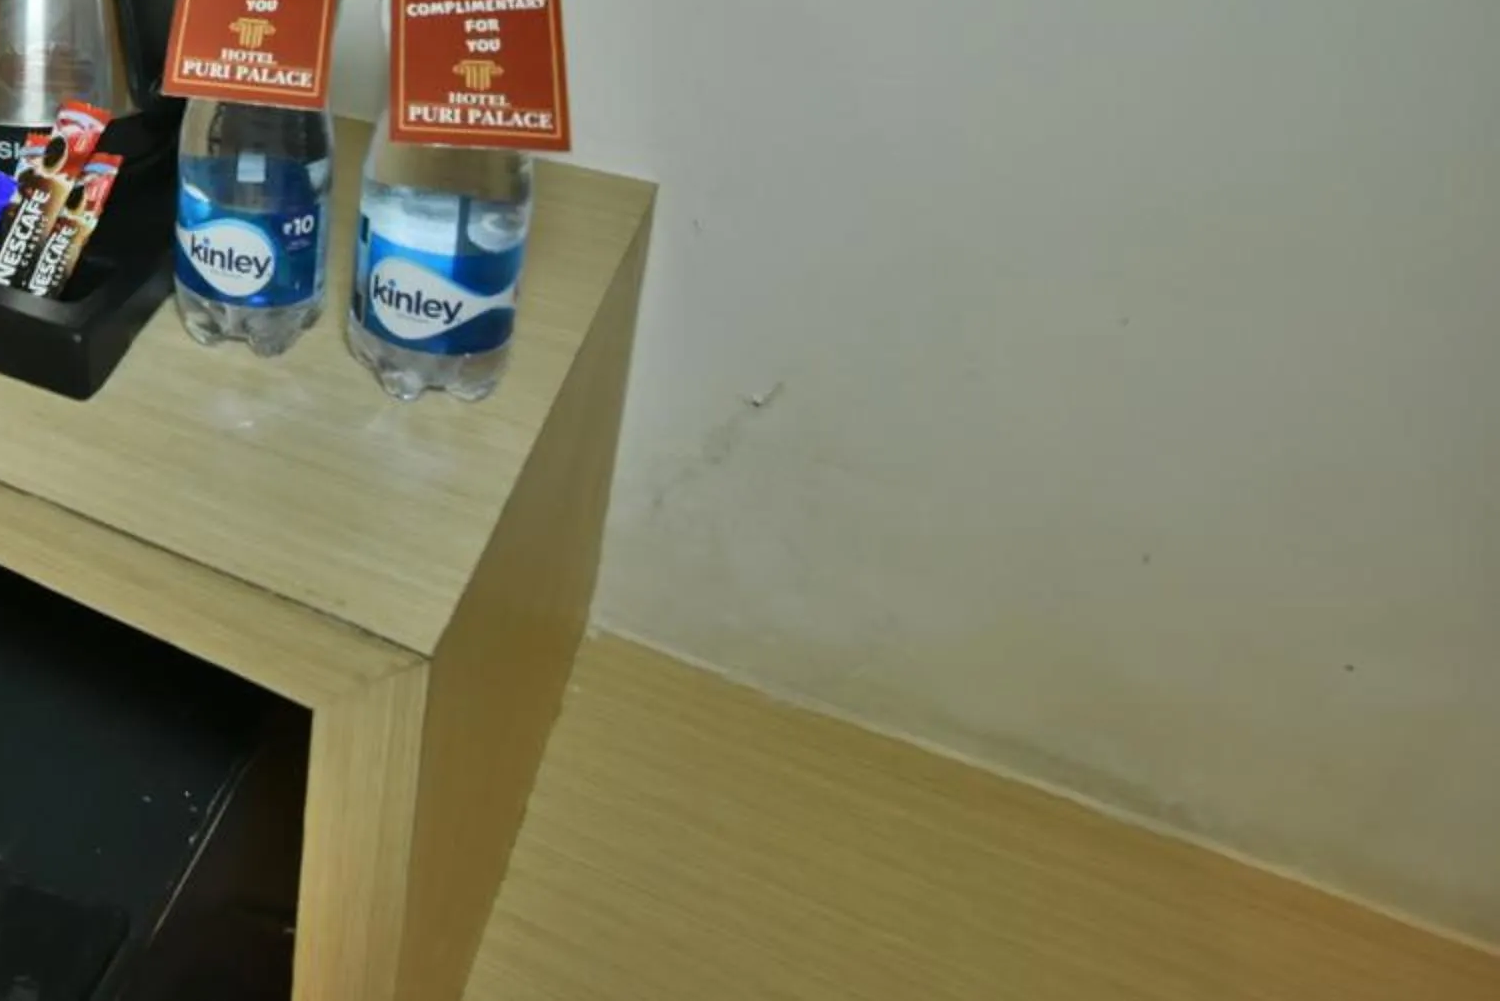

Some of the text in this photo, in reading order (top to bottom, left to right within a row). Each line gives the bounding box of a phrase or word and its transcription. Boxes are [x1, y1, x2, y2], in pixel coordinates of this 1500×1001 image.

[464, 18, 500, 33] FOR
[465, 38, 501, 53] YOU
[221, 48, 277, 65] HOTEL
[182, 59, 313, 88] PURI PALACE
[449, 91, 510, 107] HOTEL
[408, 105, 553, 129] PURI PALACE
[191, 233, 271, 279] kinley
[374, 274, 463, 325] kinley
